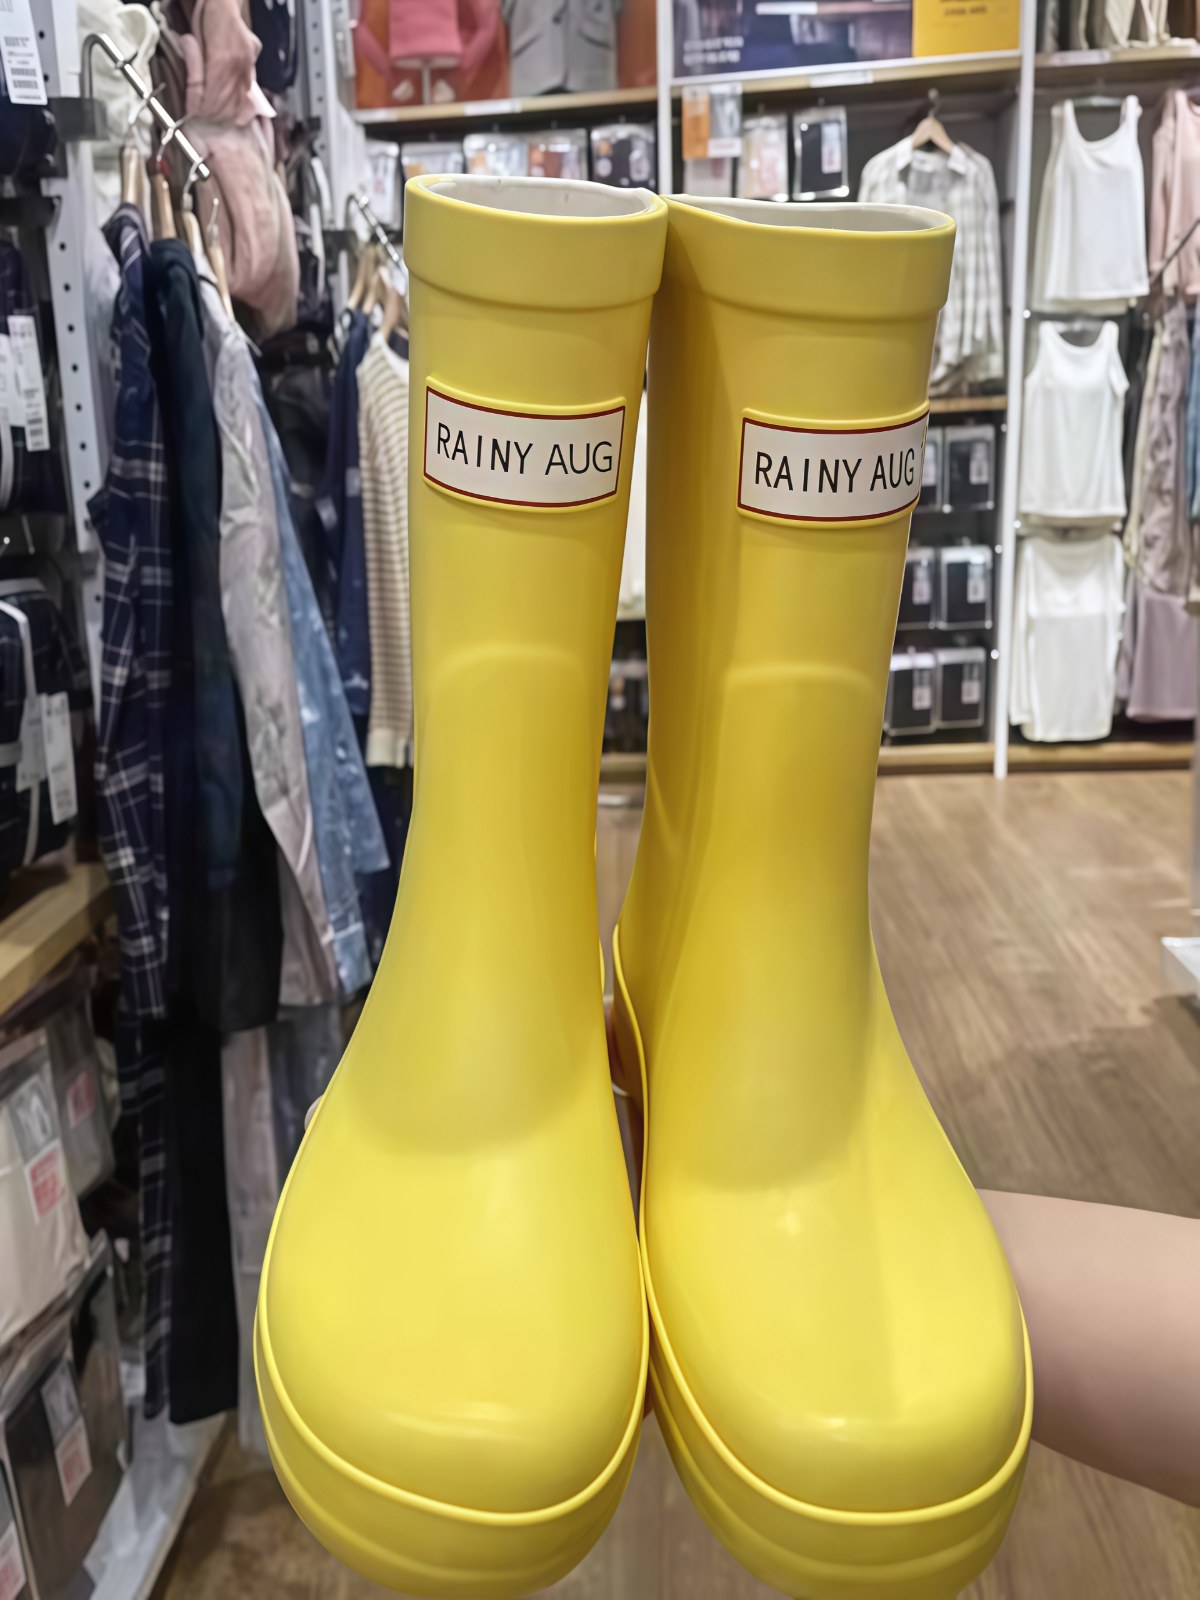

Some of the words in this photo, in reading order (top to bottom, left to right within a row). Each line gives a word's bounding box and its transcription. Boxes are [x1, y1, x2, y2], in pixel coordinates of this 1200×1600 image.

[437, 422, 534, 475] RAINY
[544, 440, 613, 476] AUG
[754, 450, 863, 493] RAINY
[869, 447, 915, 492] AUG
